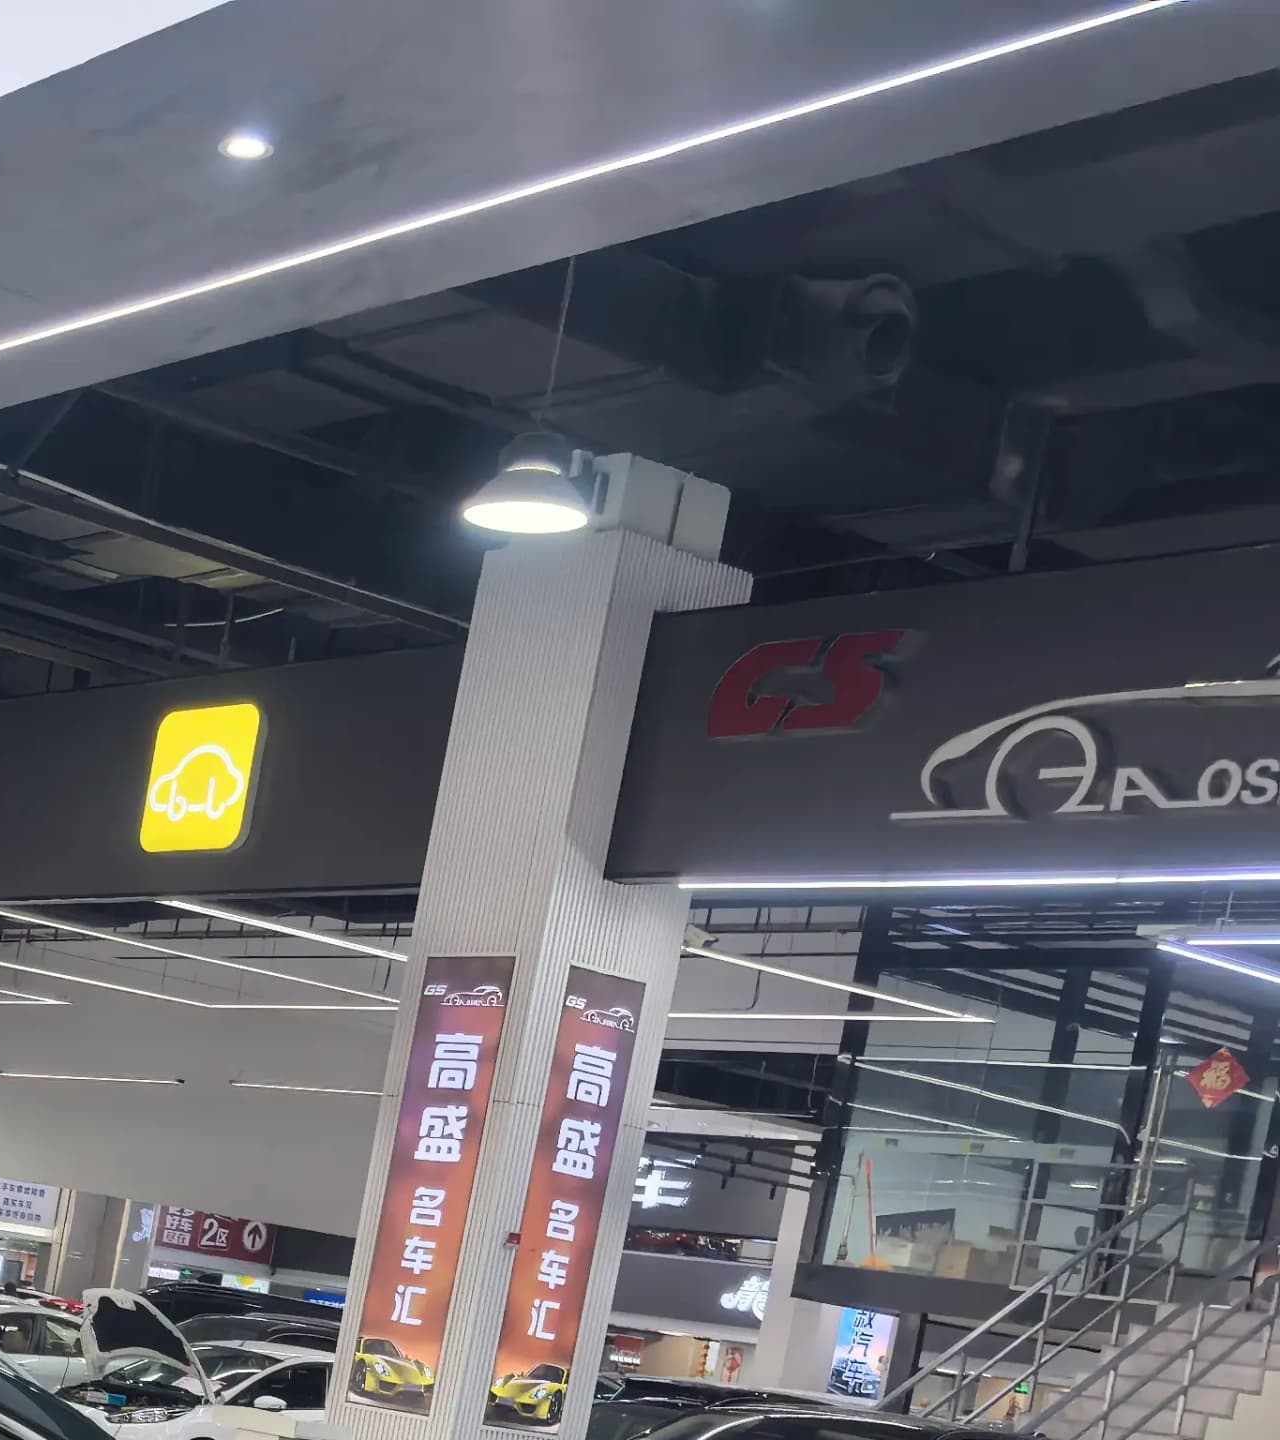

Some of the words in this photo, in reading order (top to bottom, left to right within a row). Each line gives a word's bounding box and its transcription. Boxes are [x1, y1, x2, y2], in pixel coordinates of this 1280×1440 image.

[424, 984, 448, 996] GS
[565, 995, 588, 1010] GS
[391, 1032, 483, 1327] 高盛名车汇
[526, 1044, 618, 1341] 高盛名车汇
[165, 1214, 194, 1232] 好车
[200, 1218, 229, 1248] 2区
